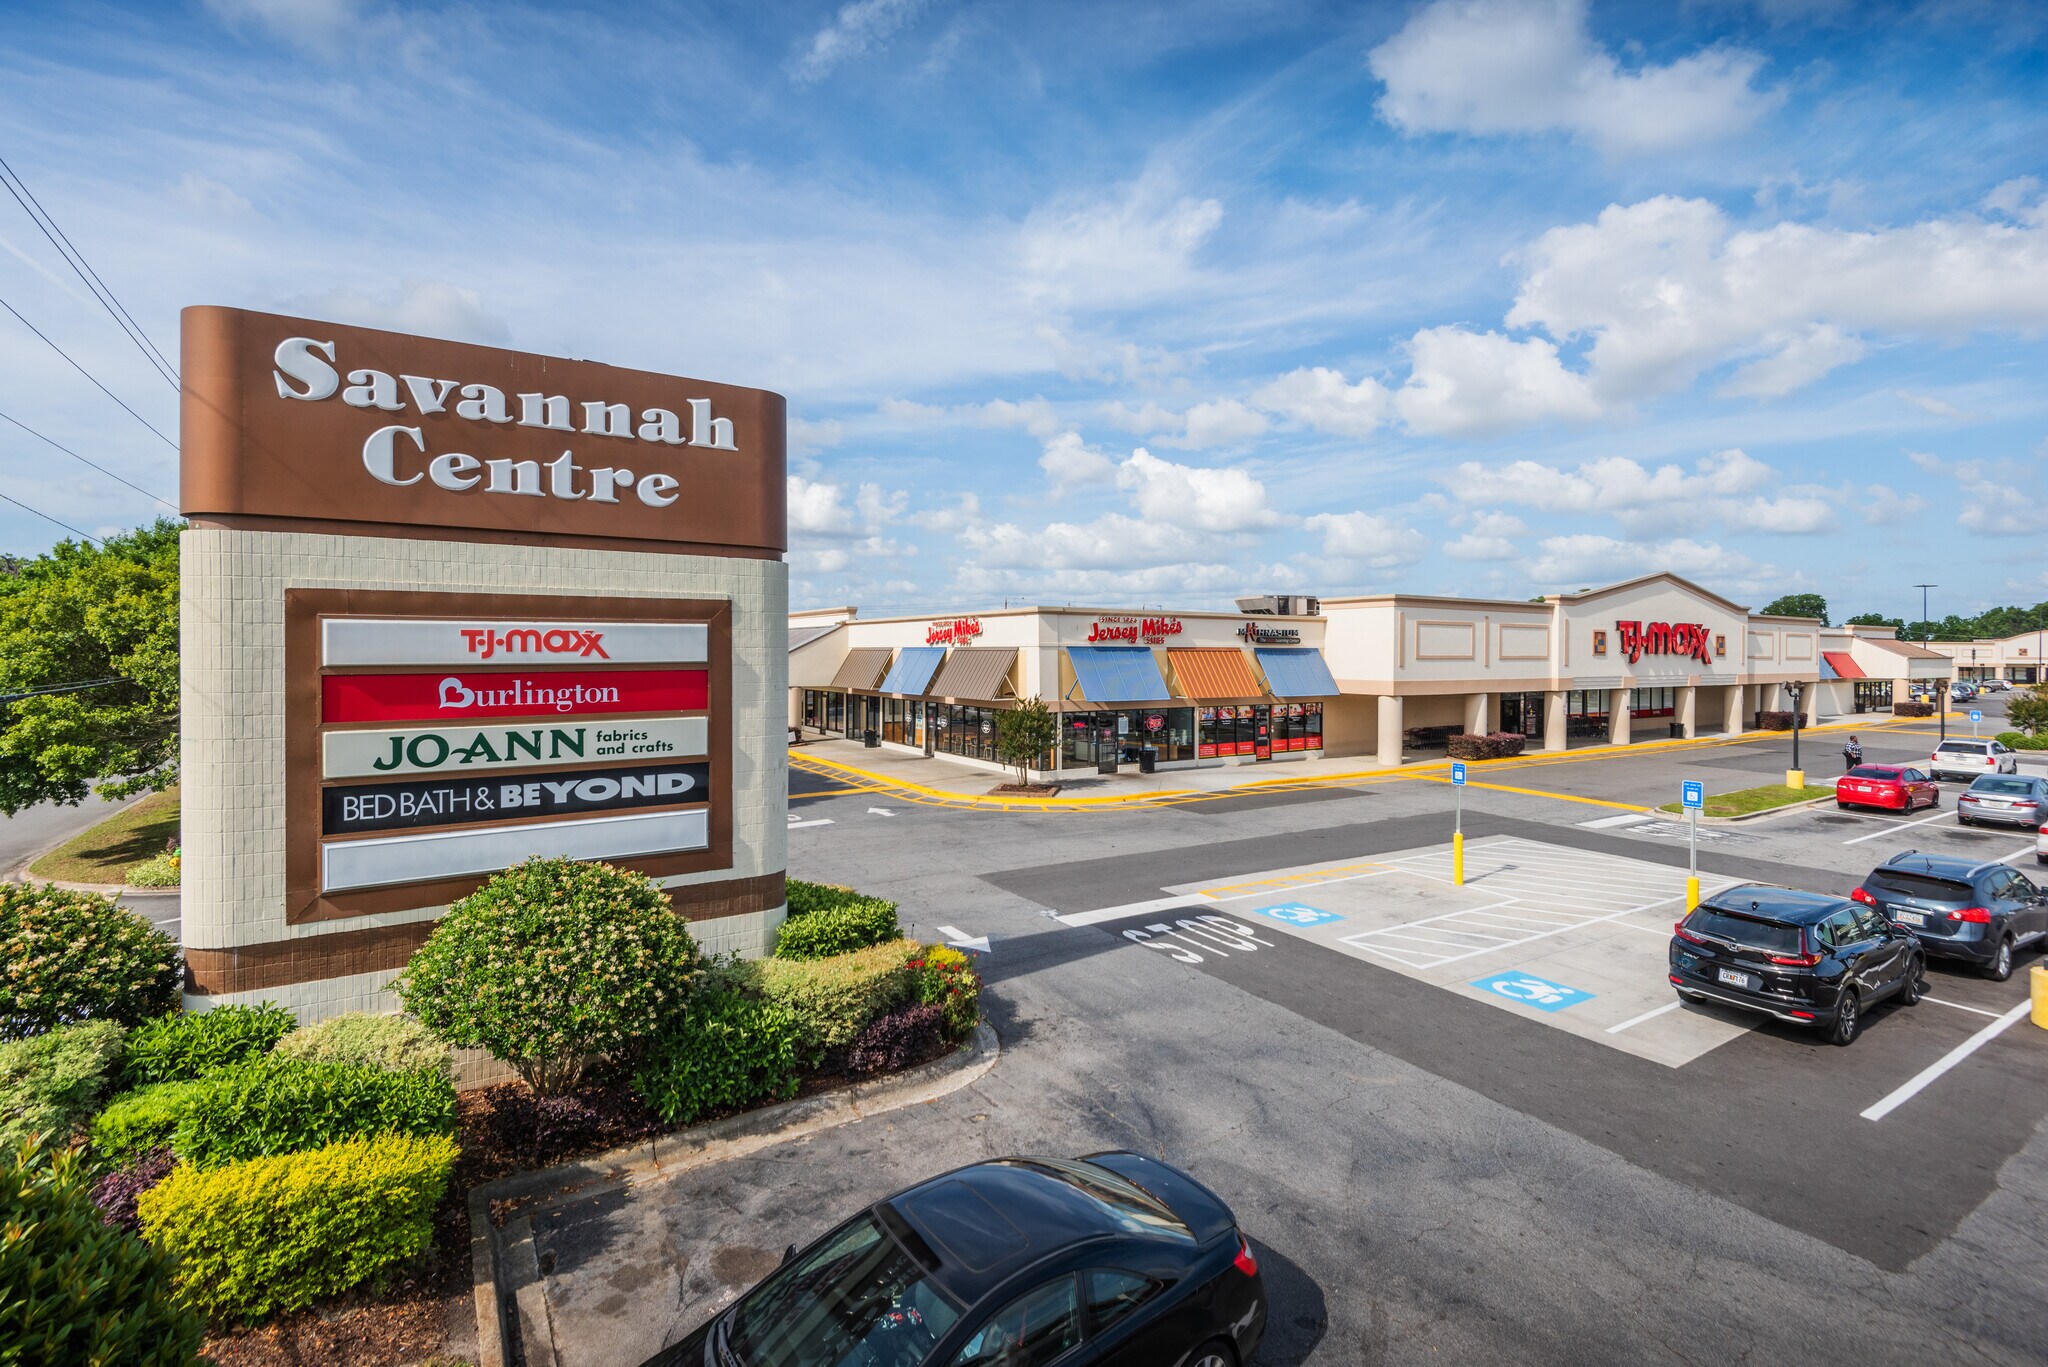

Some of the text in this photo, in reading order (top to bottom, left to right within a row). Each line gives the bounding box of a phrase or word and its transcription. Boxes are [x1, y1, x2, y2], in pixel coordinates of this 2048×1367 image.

[272, 336, 739, 452] Savannah
[361, 425, 680, 508] Centre
[926, 626, 953, 644] Jersey
[1087, 616, 1183, 645] Jersey Mike's
[438, 676, 621, 712] Burlington
[596, 729, 648, 743] fabrics
[596, 740, 674, 756] and crafts
[343, 772, 696, 822] BED BATH & BEYOND
[1122, 915, 1276, 964] STOP
